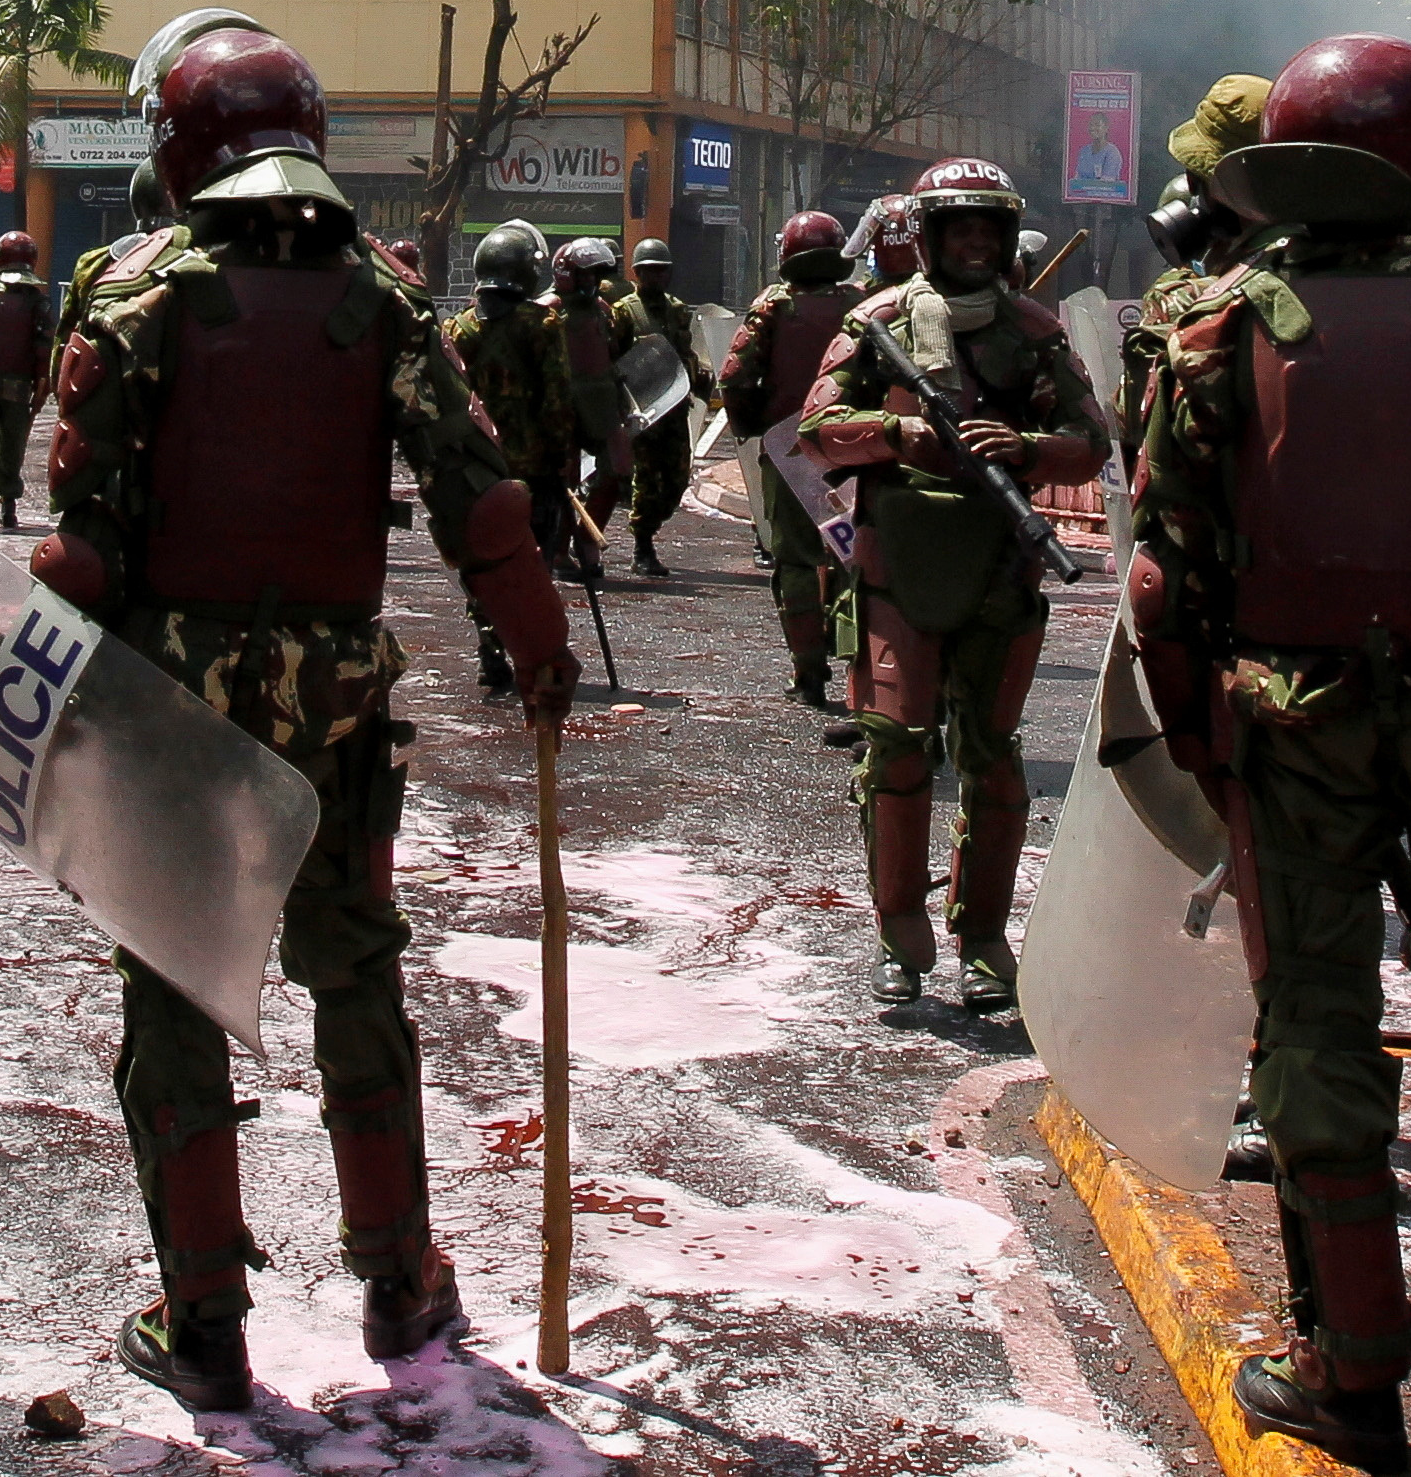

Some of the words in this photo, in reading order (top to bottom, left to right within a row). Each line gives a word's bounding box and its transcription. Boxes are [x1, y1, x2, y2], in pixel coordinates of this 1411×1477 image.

[69, 122, 149, 135] MAGNATE
[80, 150, 104, 160] 0722
[107, 150, 126, 160] 204
[691, 137, 732, 169] TECNO
[931, 163, 1011, 189] POLICE
[883, 233, 915, 247] POLIC
